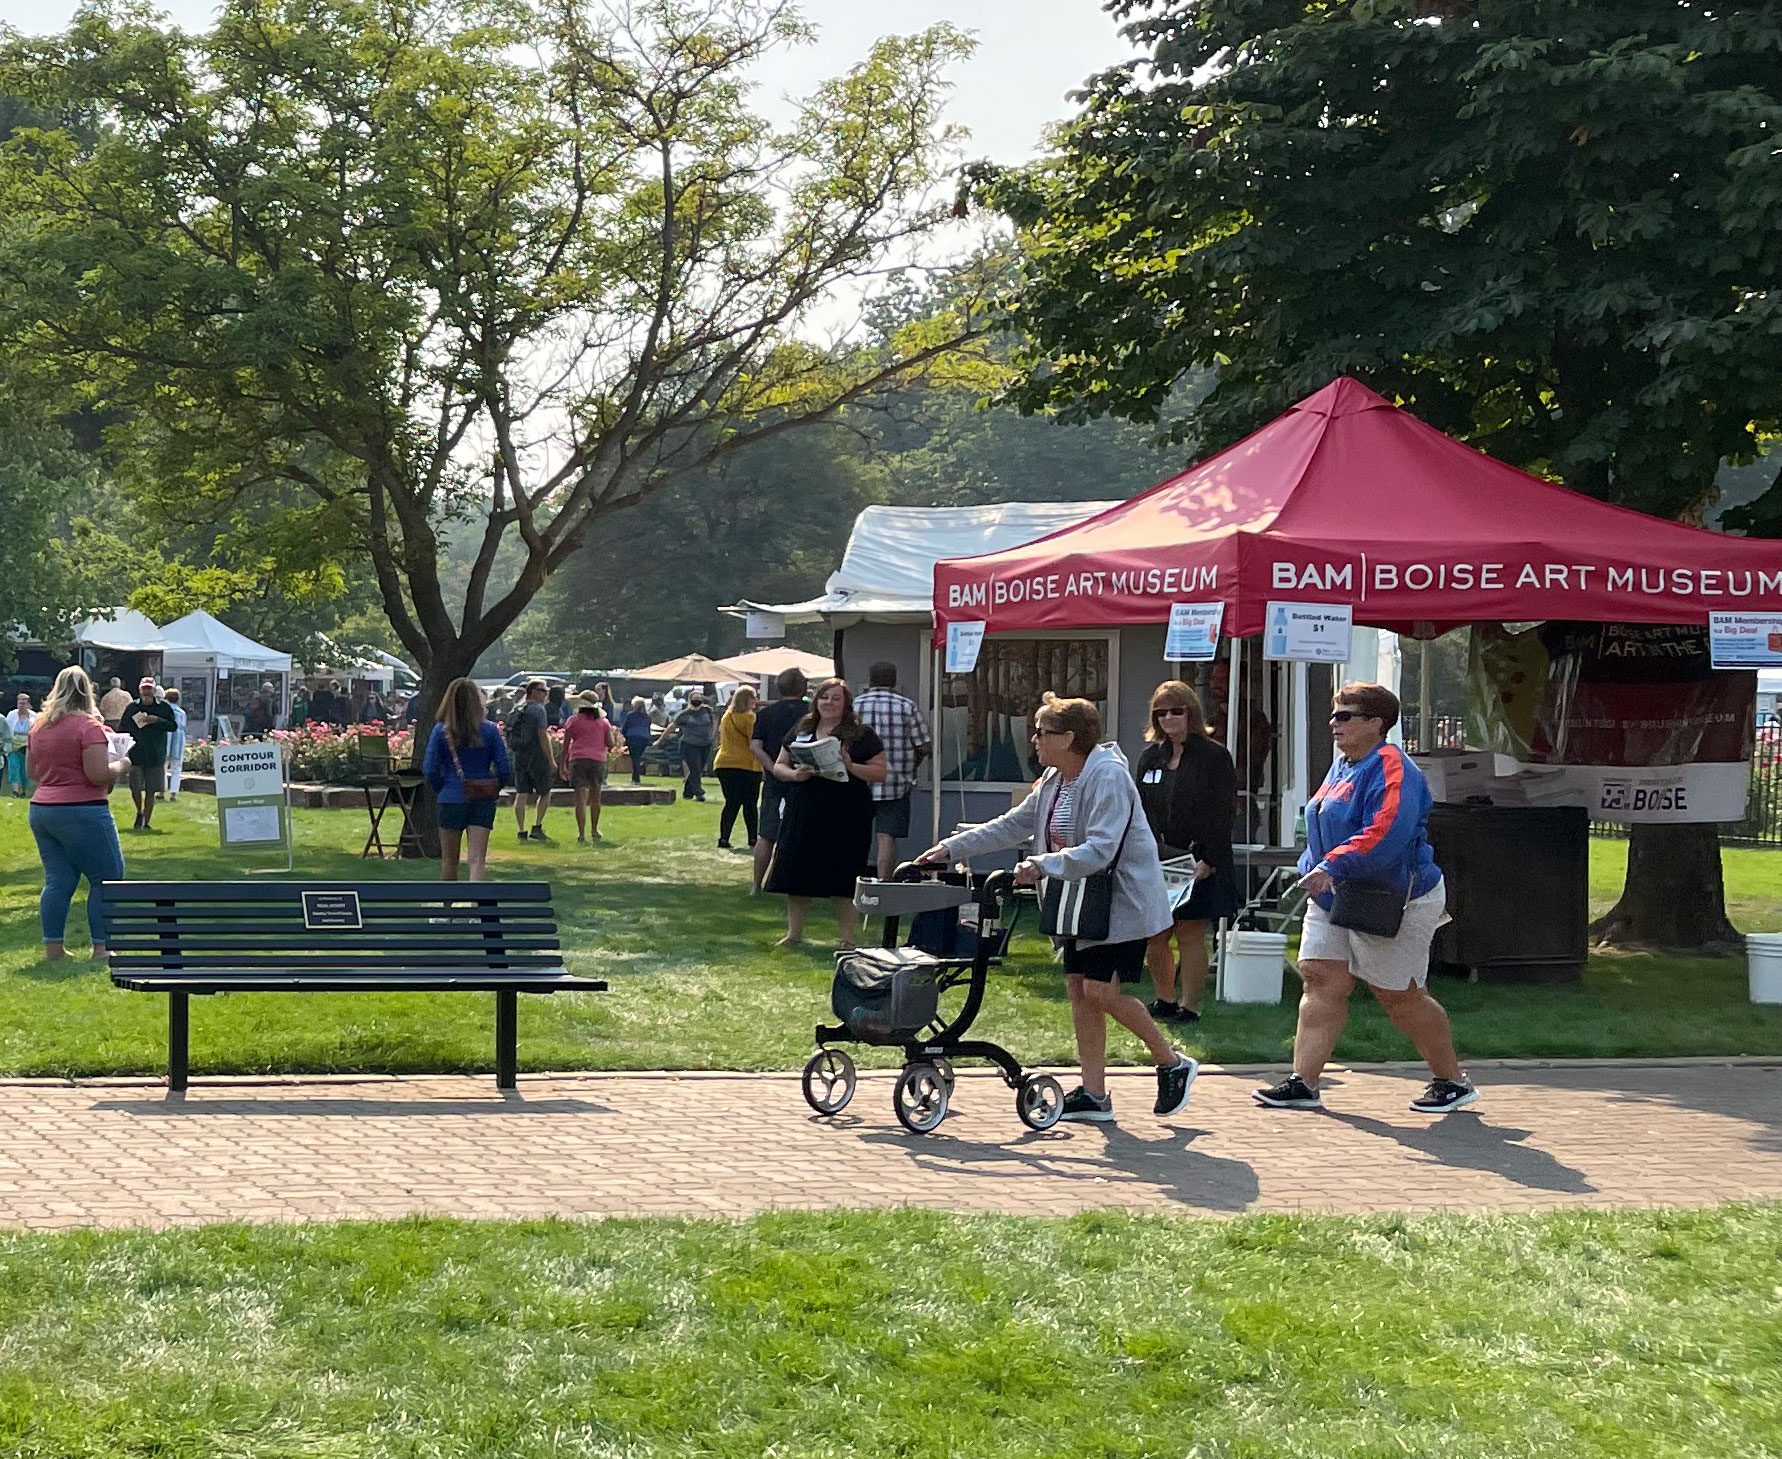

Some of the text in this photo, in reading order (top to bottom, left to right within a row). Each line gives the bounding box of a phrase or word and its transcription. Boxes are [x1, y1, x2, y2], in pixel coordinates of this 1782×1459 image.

[949, 564, 1219, 608] BAM BOISE ART MUSEUM
[1273, 562, 1782, 597] BAM BOISE ART MUSEUM
[220, 762, 277, 774] CORRIDOR
[221, 751, 274, 763] CONTOUR
[1633, 787, 1688, 811] BOISE
